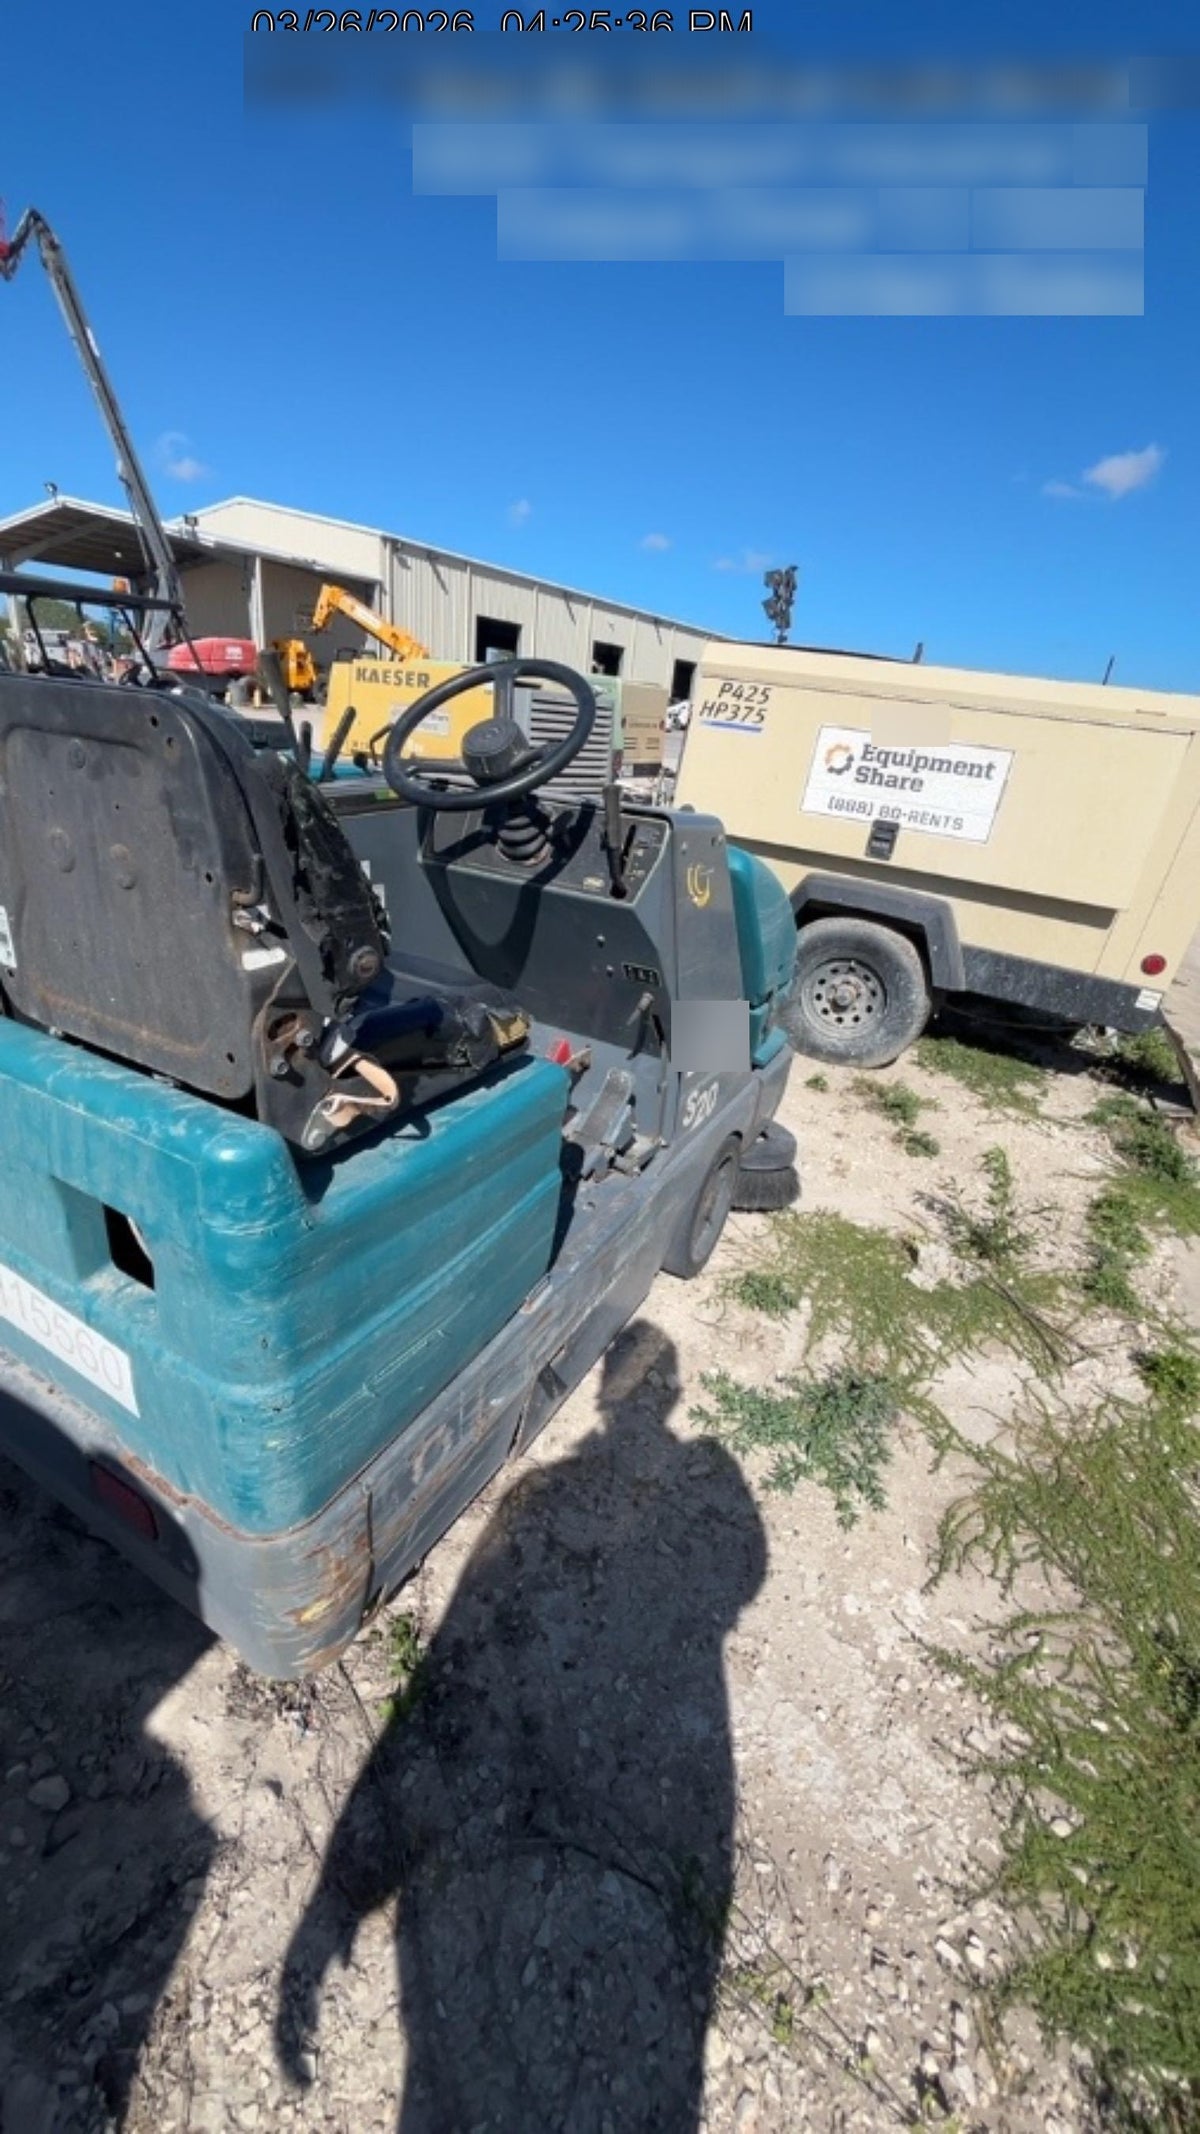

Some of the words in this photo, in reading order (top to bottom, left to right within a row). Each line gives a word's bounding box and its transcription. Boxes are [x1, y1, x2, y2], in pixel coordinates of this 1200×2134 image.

[355, 666, 430, 688] KAESER
[718, 682, 771, 704] P425
[699, 701, 767, 724] HP375
[860, 744, 996, 780] Equipment
[855, 765, 924, 792] Share
